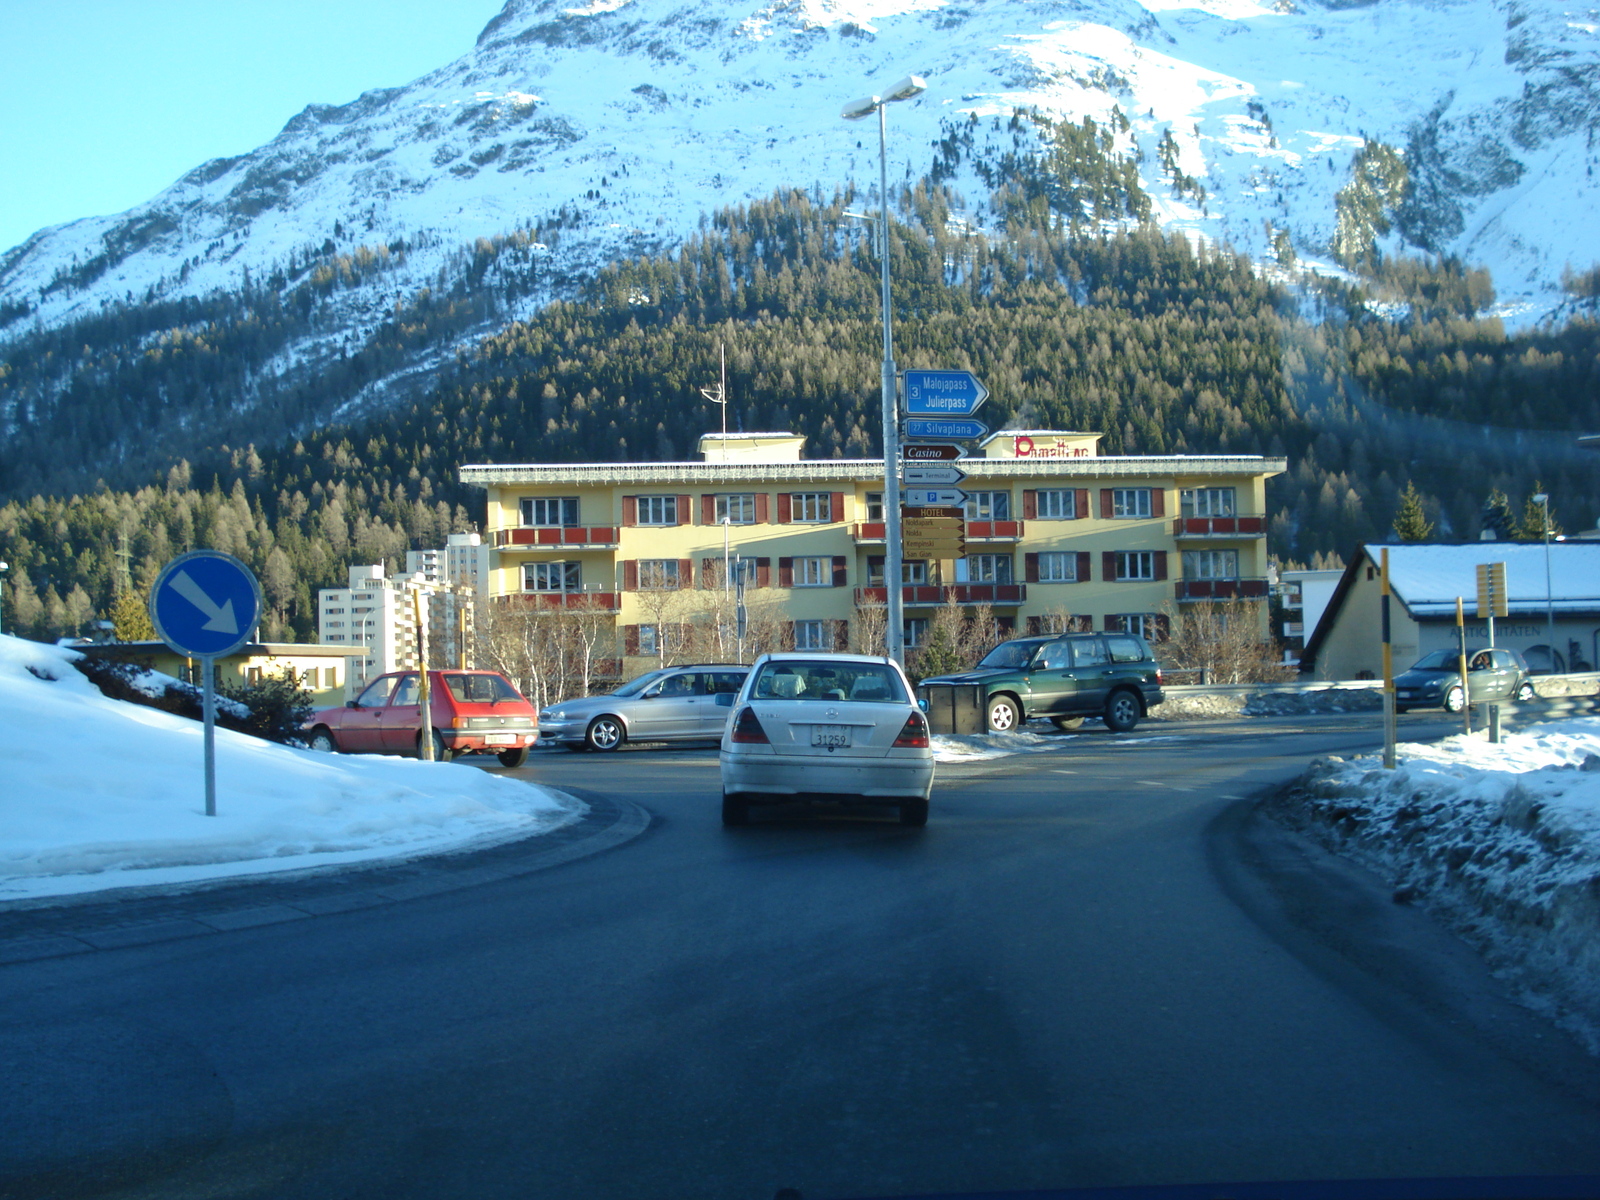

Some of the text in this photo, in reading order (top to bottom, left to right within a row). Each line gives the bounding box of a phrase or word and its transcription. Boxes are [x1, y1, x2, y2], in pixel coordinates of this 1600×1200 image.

[923, 377, 967, 392] Malojapass
[911, 386, 919, 397] 3
[926, 395, 966, 410] Julierpass
[926, 423, 972, 436] Silvaplana
[908, 447, 942, 457] Casino
[920, 508, 945, 517] HOTEL
[817, 734, 847, 746] 31259
